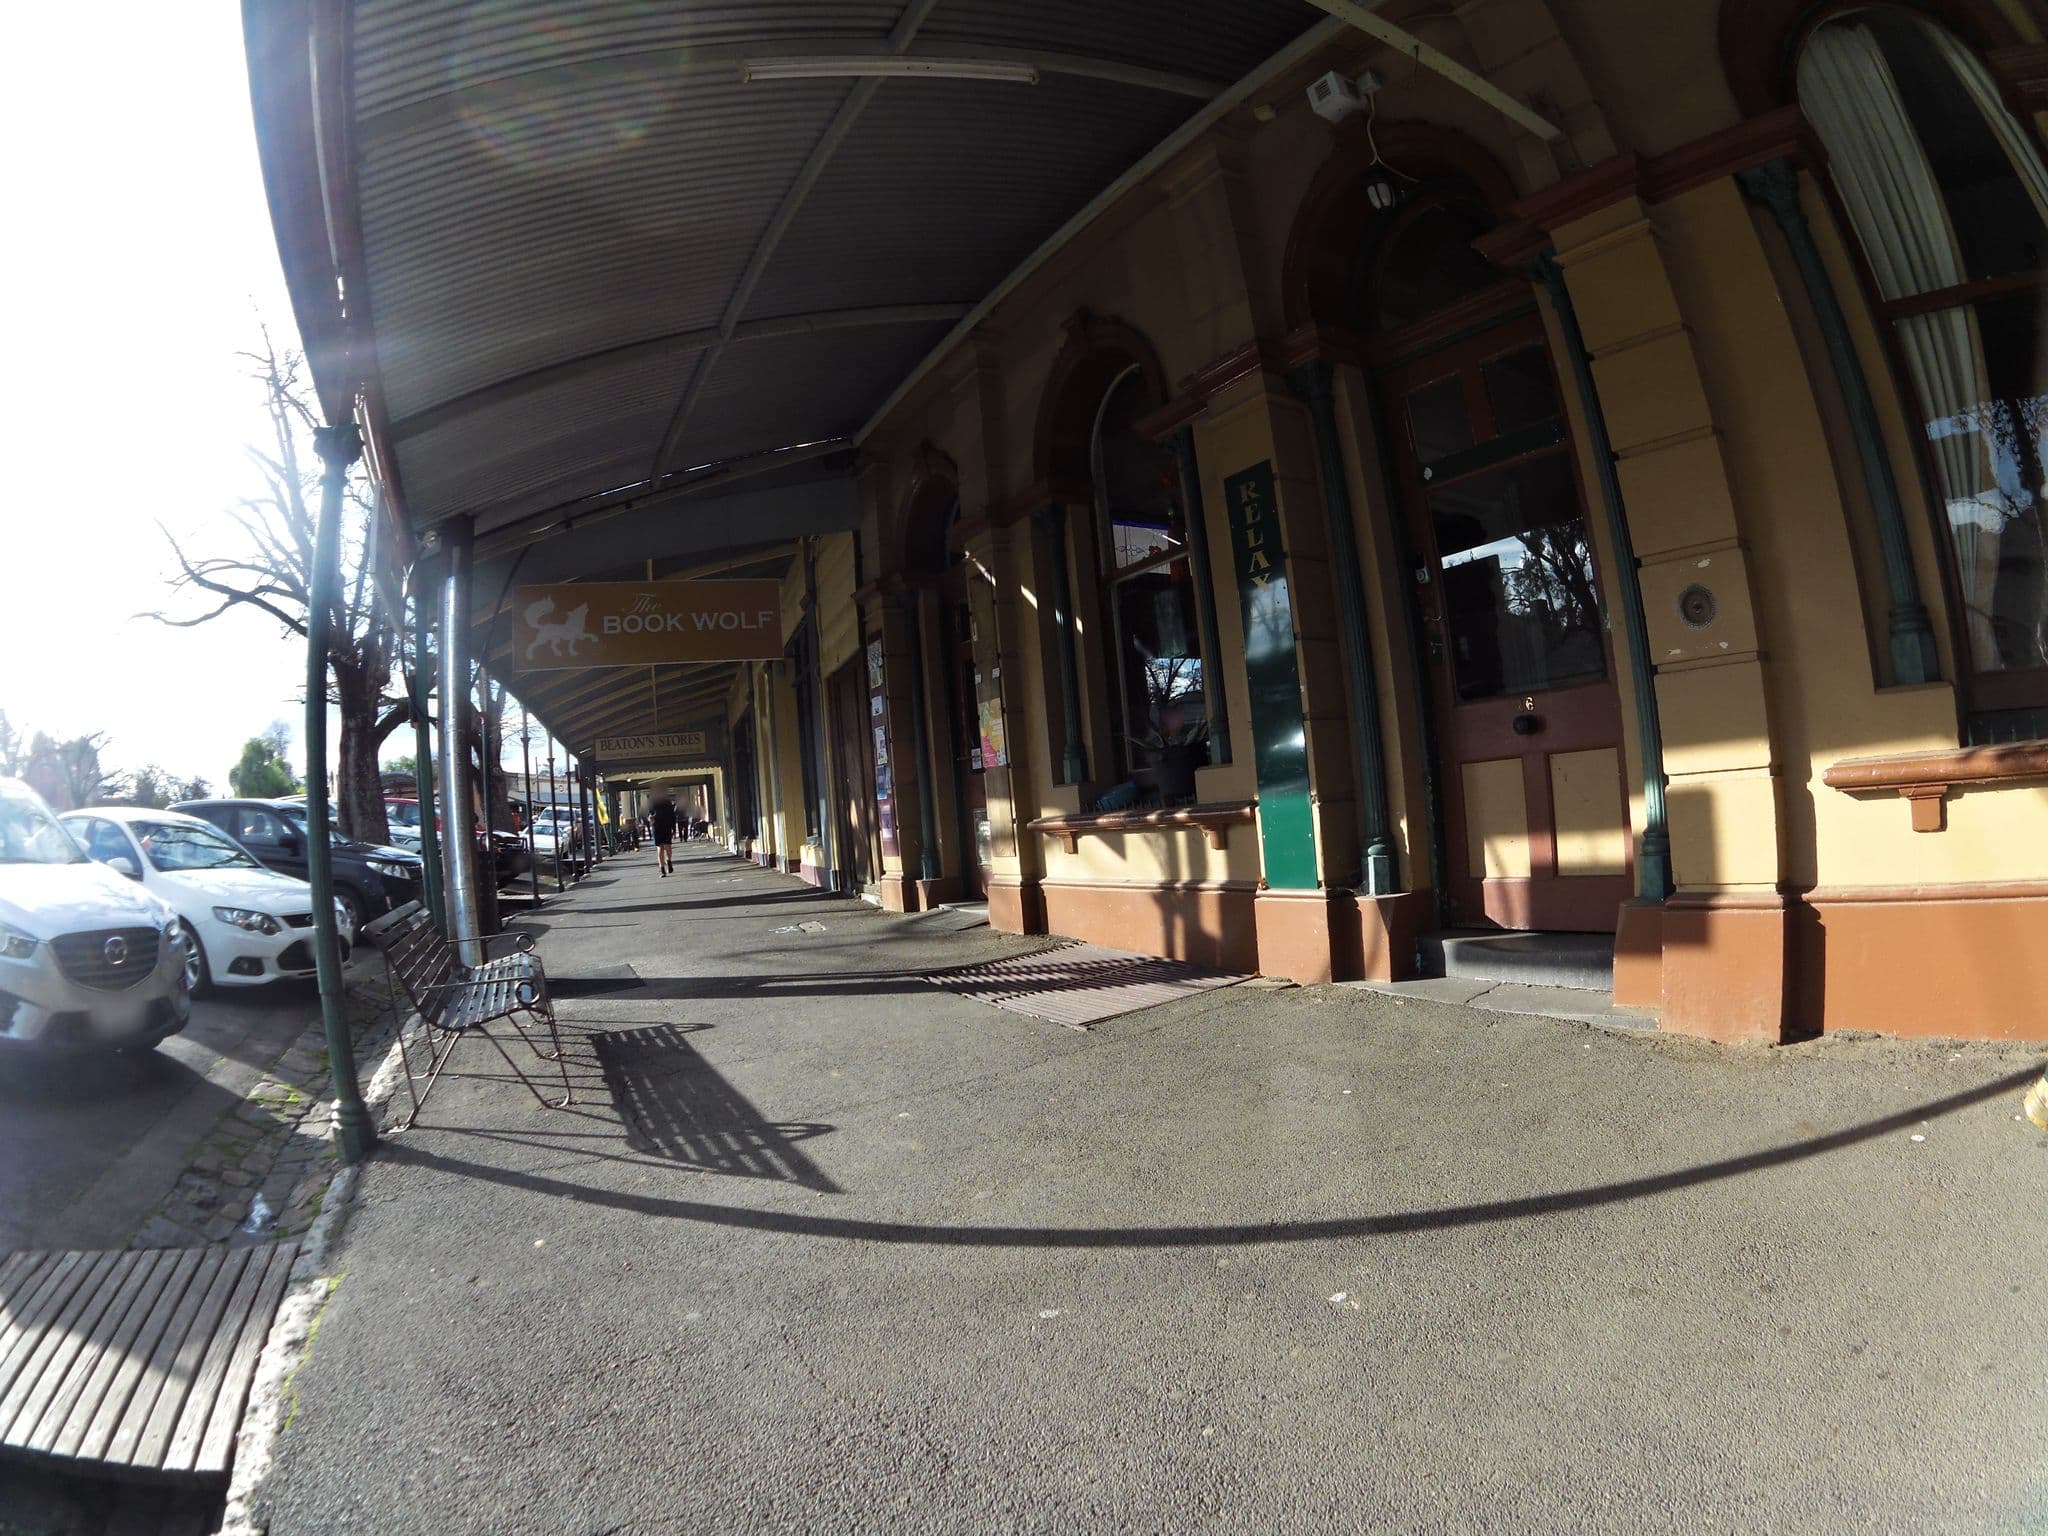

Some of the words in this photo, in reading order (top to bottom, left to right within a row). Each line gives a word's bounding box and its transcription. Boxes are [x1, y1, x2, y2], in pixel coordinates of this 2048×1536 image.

[631, 593, 662, 613] The
[603, 612, 684, 634] BOOK
[690, 611, 773, 631] WOLF
[600, 736, 655, 751] BEATON'S
[658, 733, 701, 748] STORES
